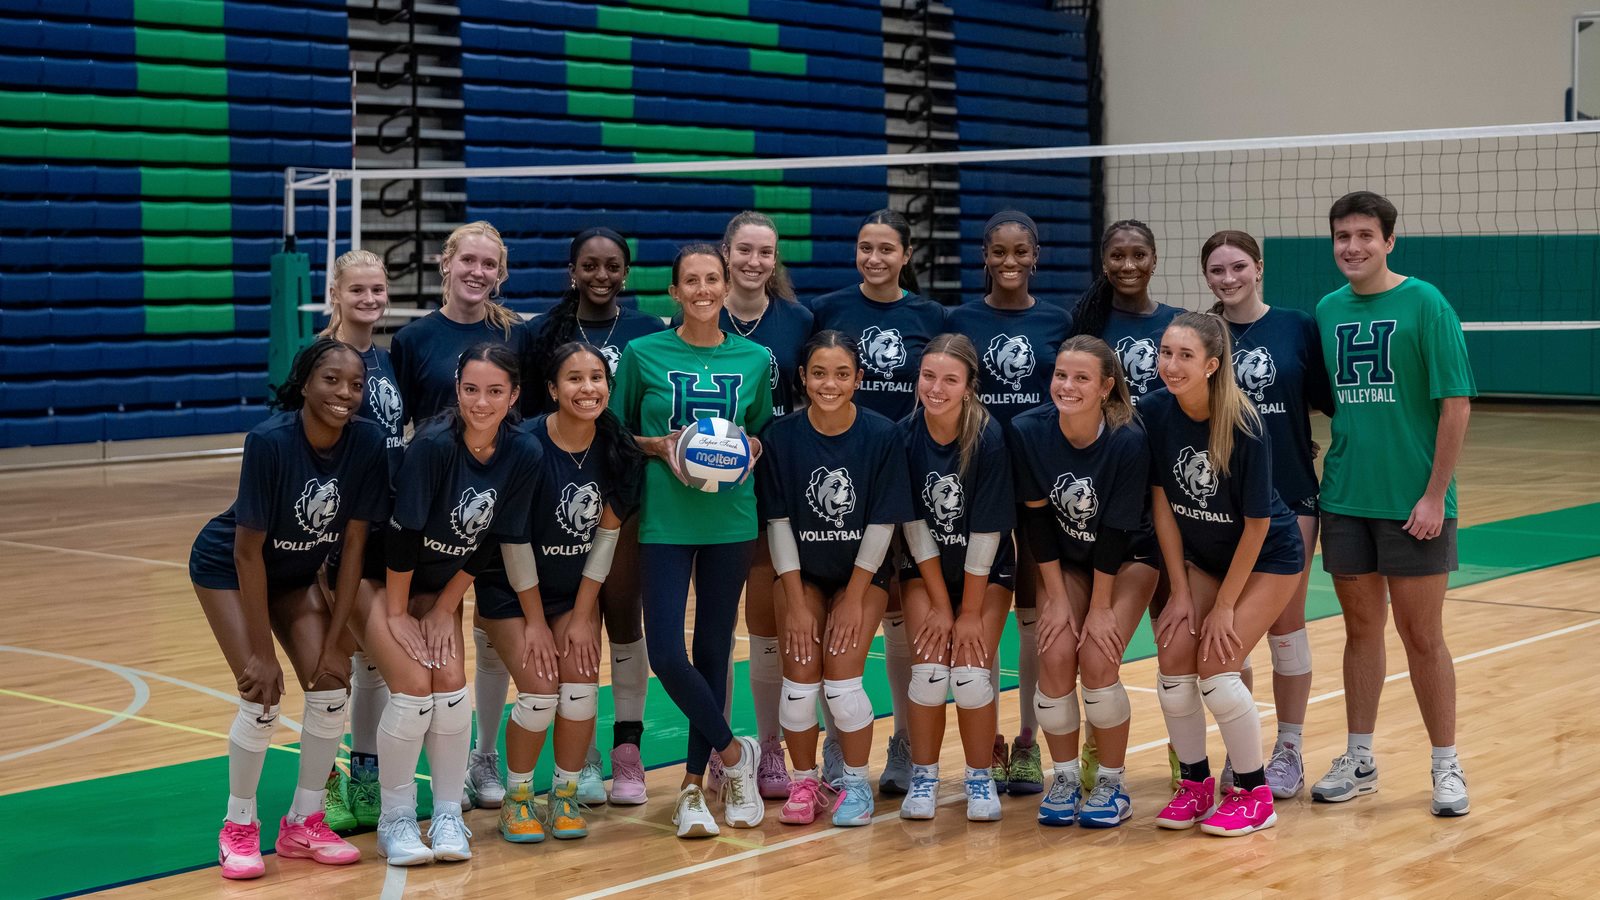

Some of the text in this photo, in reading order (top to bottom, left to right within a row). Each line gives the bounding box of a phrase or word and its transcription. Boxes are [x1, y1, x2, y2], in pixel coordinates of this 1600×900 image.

[1335, 320, 1397, 386] H
[668, 371, 743, 431] H
[695, 451, 739, 466] molten
[1171, 502, 1234, 523] VOLLEYBALL
[799, 529, 863, 542] VOLLEYBAL
